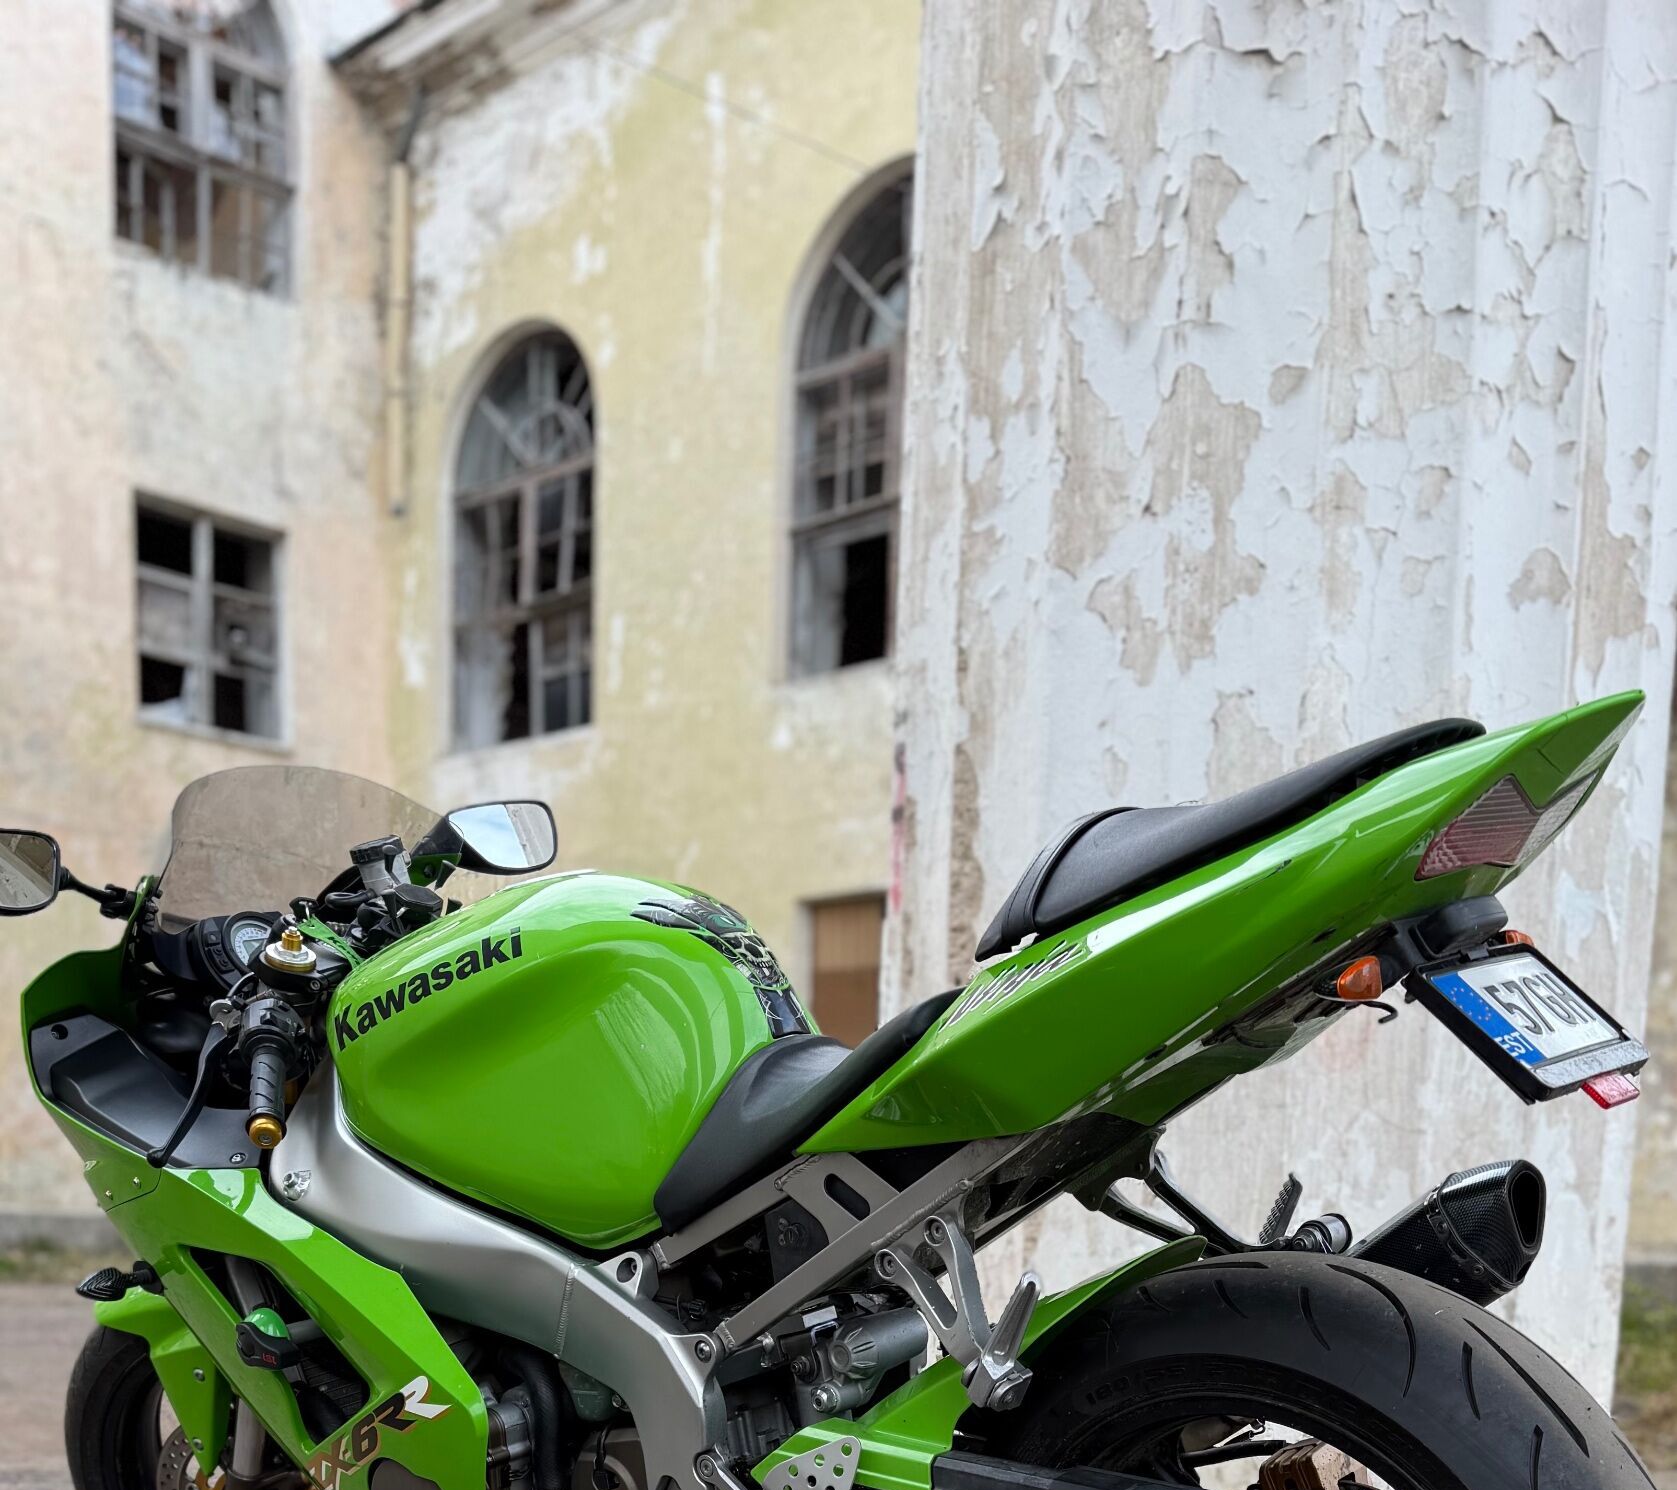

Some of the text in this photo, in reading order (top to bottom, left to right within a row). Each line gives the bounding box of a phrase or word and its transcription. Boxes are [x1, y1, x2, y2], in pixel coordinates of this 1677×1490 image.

[334, 926, 523, 1051] Kawasaki
[1482, 972, 1597, 1036] 57GH
[1494, 1031, 1534, 1057] EST
